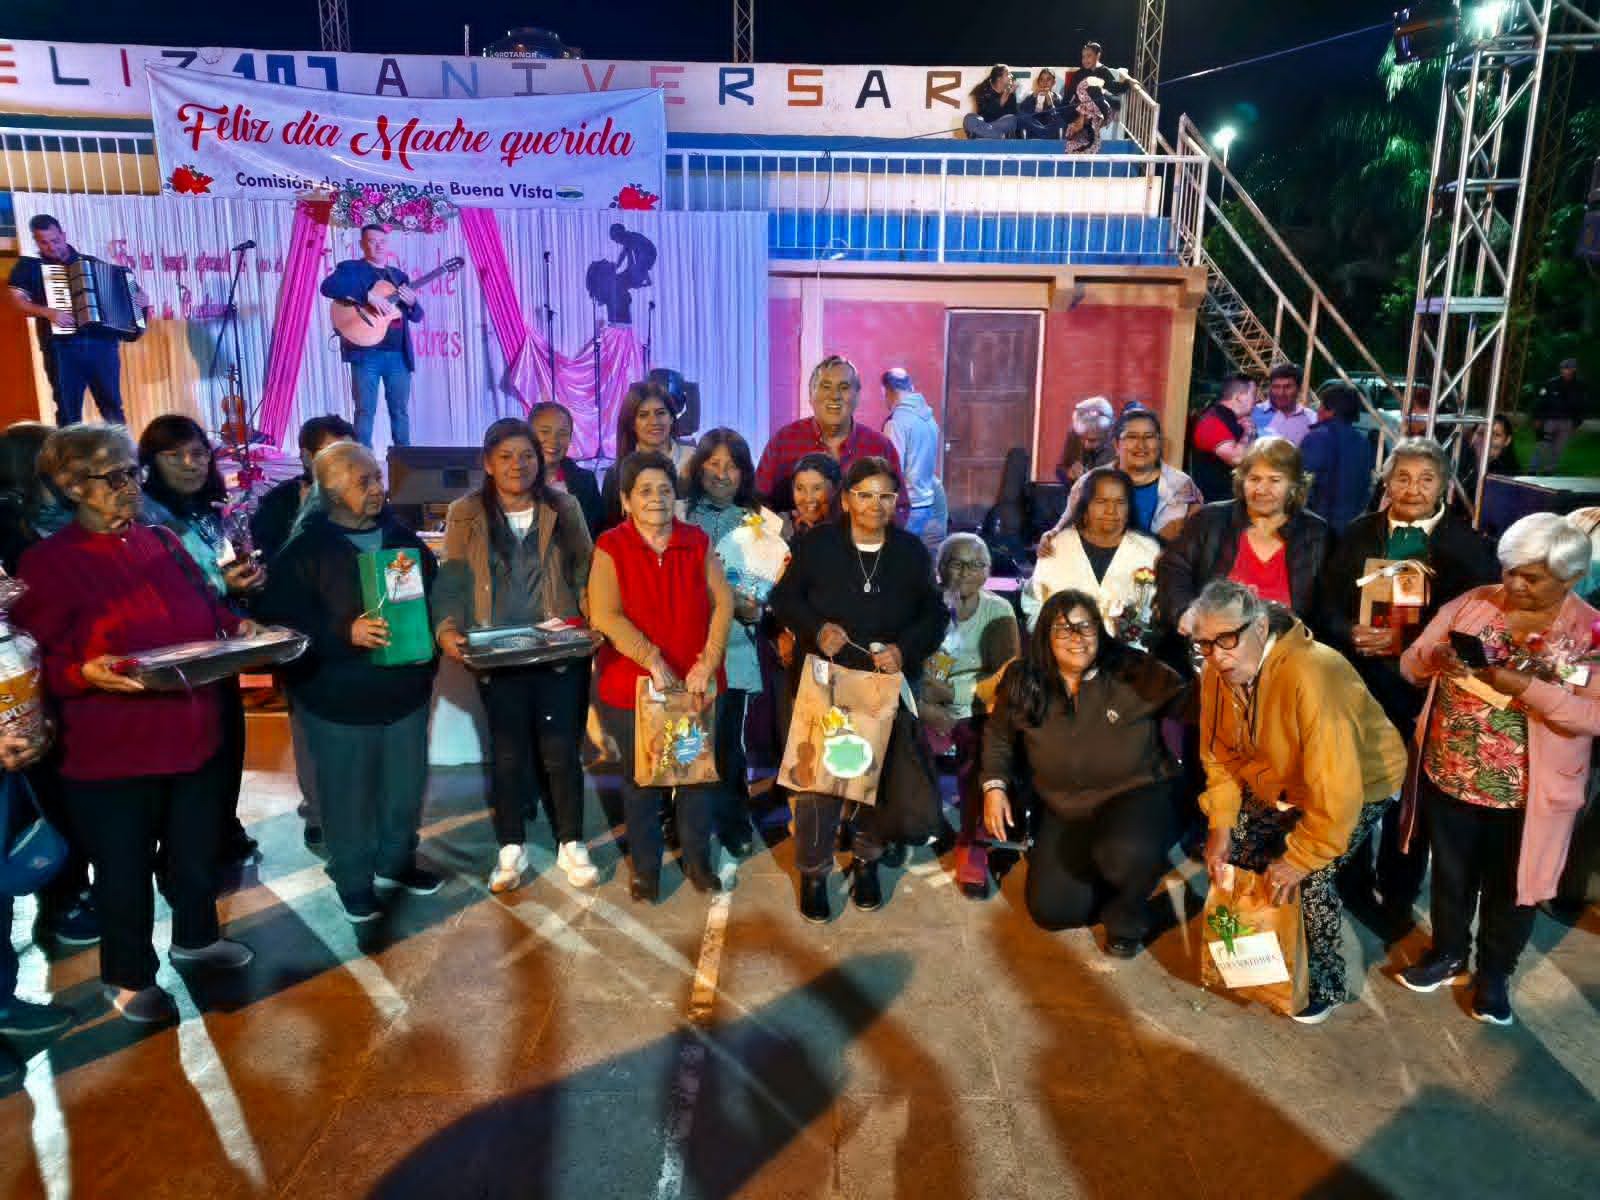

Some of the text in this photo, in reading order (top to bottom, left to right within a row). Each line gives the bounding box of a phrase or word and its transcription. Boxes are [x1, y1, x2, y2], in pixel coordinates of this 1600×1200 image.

[375, 57, 1080, 109] ANIVERSAR
[177, 103, 273, 151] Feliz
[350, 115, 493, 171] Madre
[501, 117, 635, 168] querida
[236, 172, 313, 190] Comisión
[424, 182, 444, 196] de
[451, 182, 504, 197] Buena
[510, 183, 553, 199] Vista
